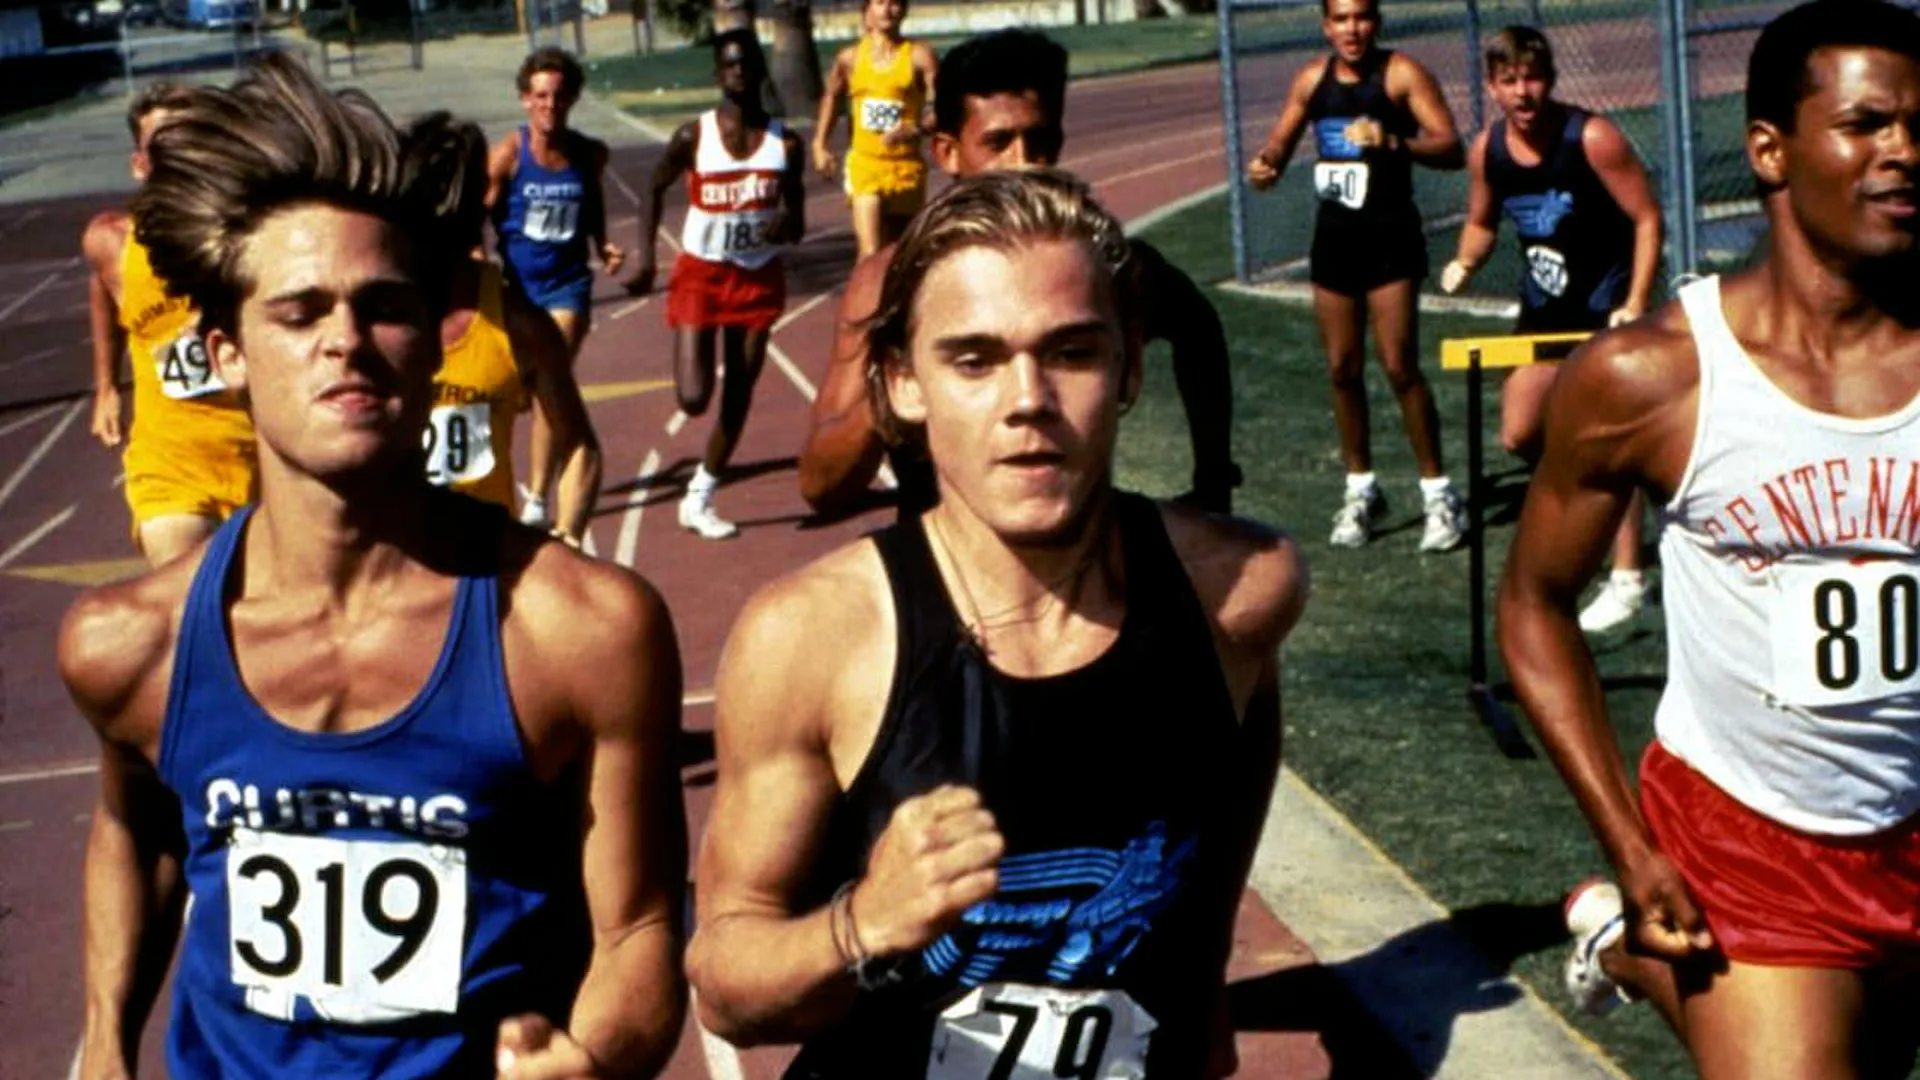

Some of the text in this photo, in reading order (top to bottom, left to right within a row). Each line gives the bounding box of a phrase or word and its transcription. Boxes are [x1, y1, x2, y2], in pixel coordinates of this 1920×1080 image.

[163, 339, 212, 391] 49
[421, 413, 468, 475] 29
[1814, 573, 1920, 691] 80
[206, 778, 470, 838] CURTIS
[234, 853, 440, 986] 319
